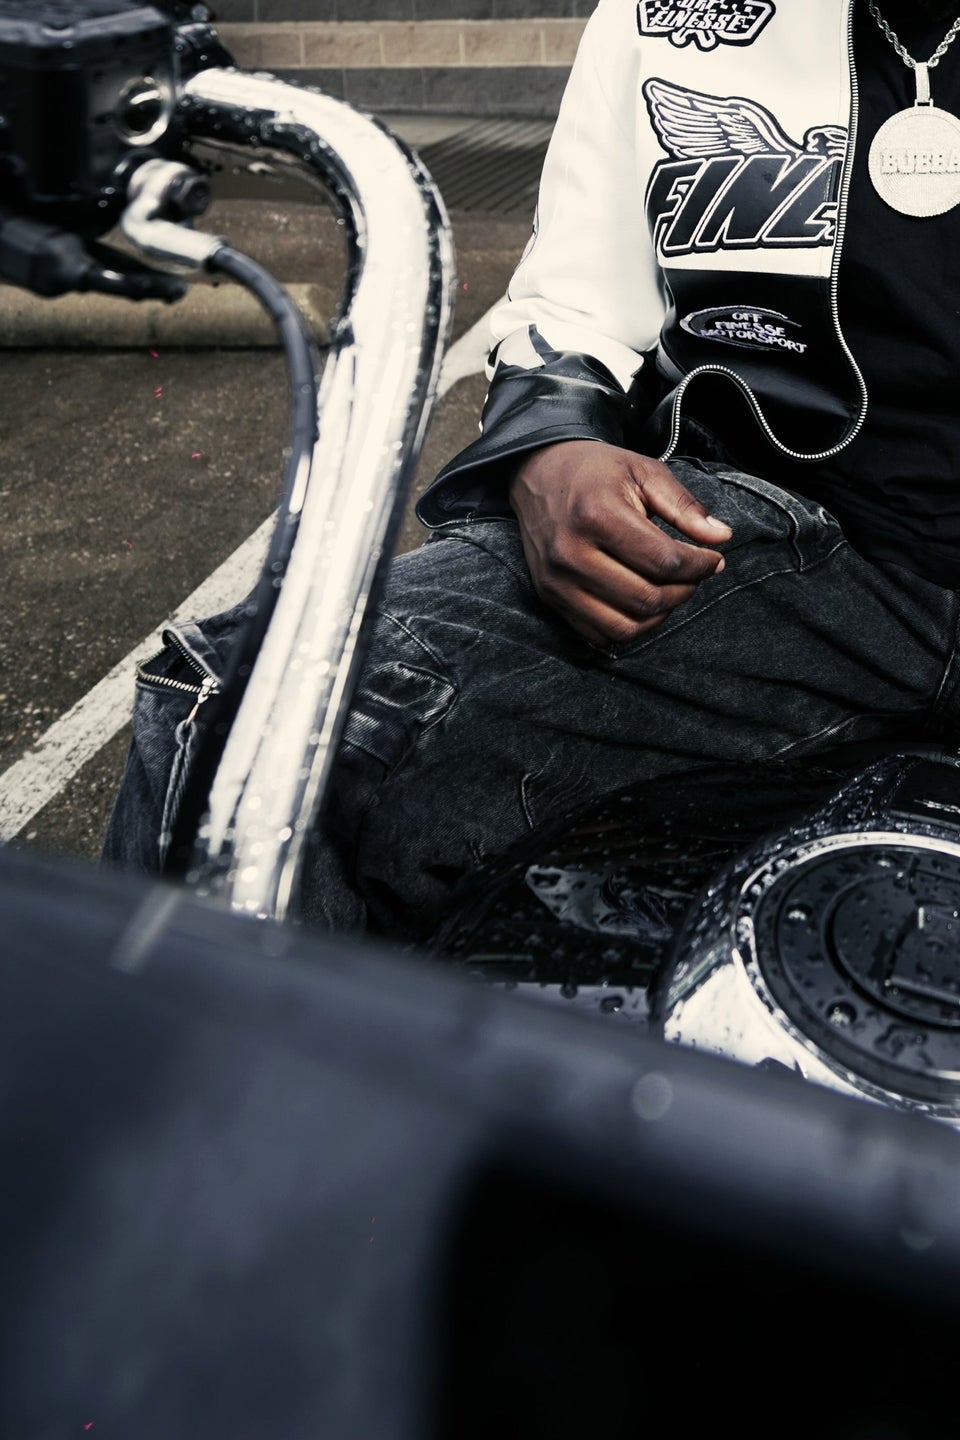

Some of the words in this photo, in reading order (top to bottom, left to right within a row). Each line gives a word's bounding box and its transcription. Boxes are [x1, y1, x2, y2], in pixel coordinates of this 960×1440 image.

[648, 9, 746, 31] FINESSE
[732, 312, 763, 323] OFF
[715, 321, 786, 338] FINESSE
[700, 329, 808, 354] MOTORSPORT
